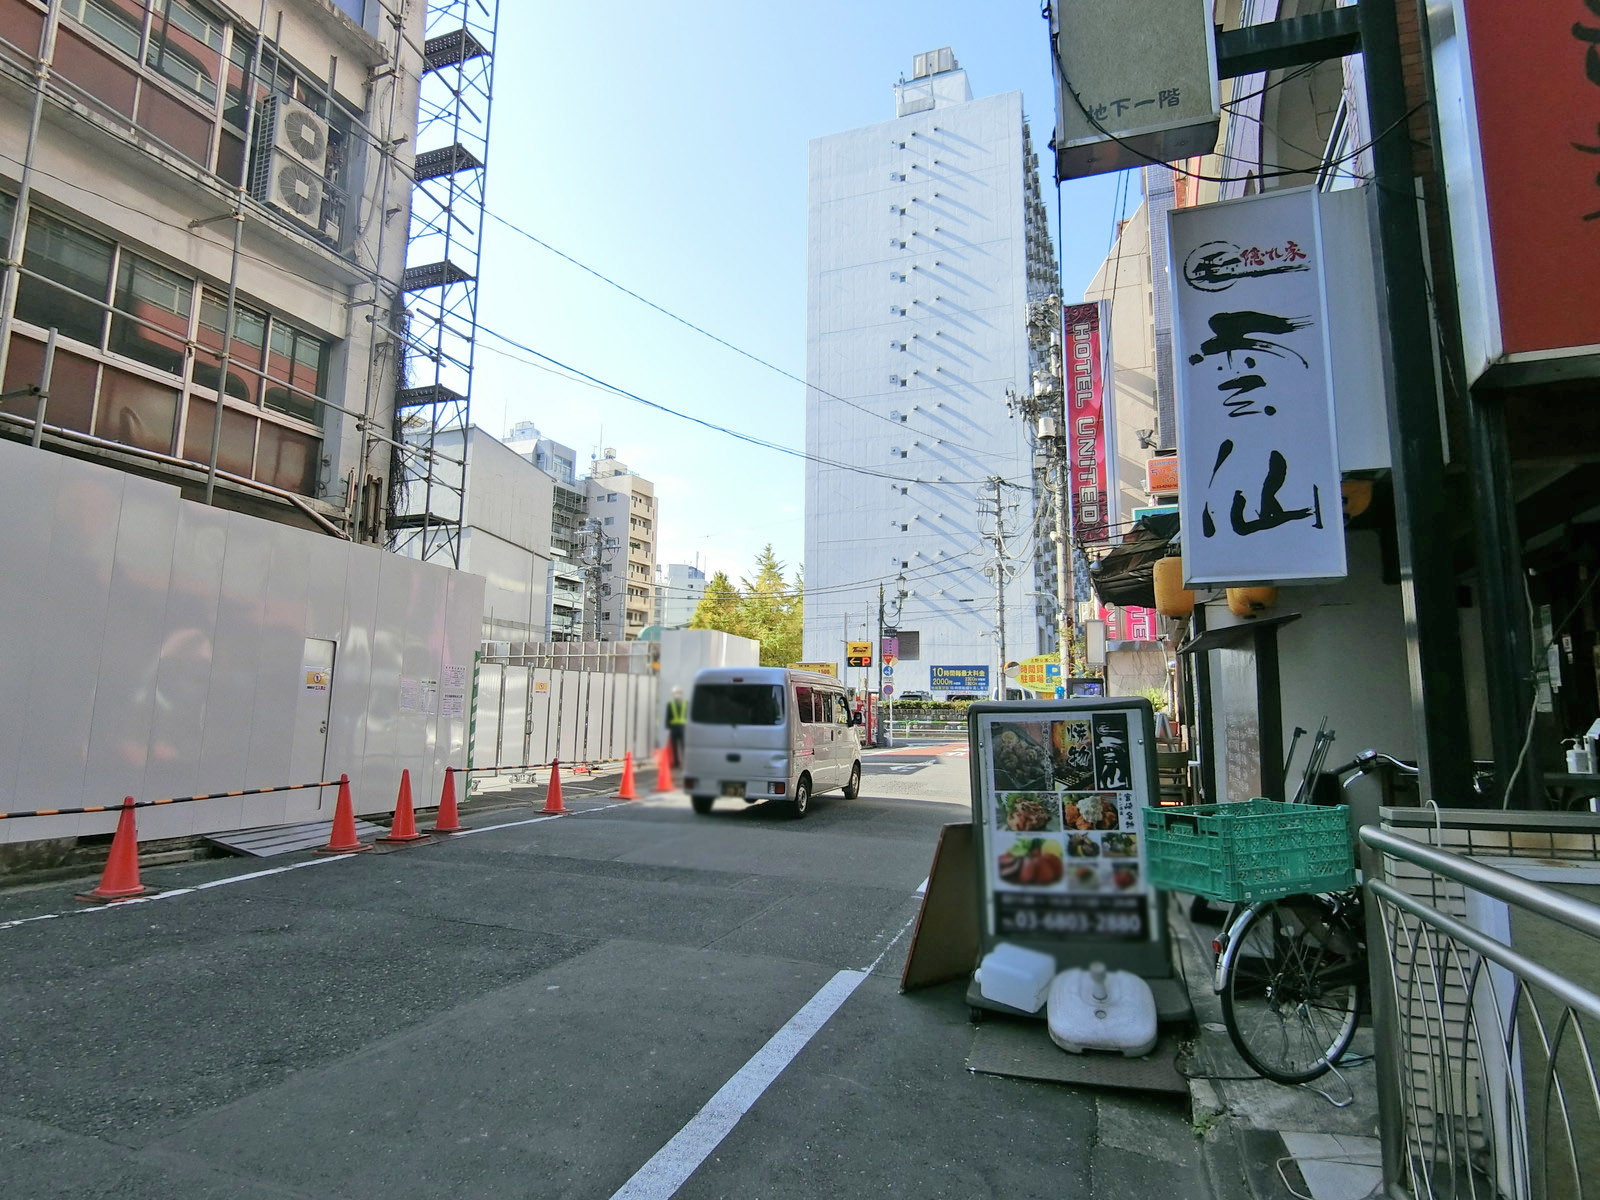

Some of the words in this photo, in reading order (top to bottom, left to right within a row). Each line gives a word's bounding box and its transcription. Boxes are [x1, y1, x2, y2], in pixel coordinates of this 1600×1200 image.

[1086, 88, 1181, 123] 地下一階
[1239, 240, 1307, 267] 隠れ家
[1073, 322, 1093, 409] HOTEL
[1076, 415, 1100, 526] UNITED
[1020, 674, 1044, 684] 駐車場
[1066, 723, 1091, 767] 焼物
